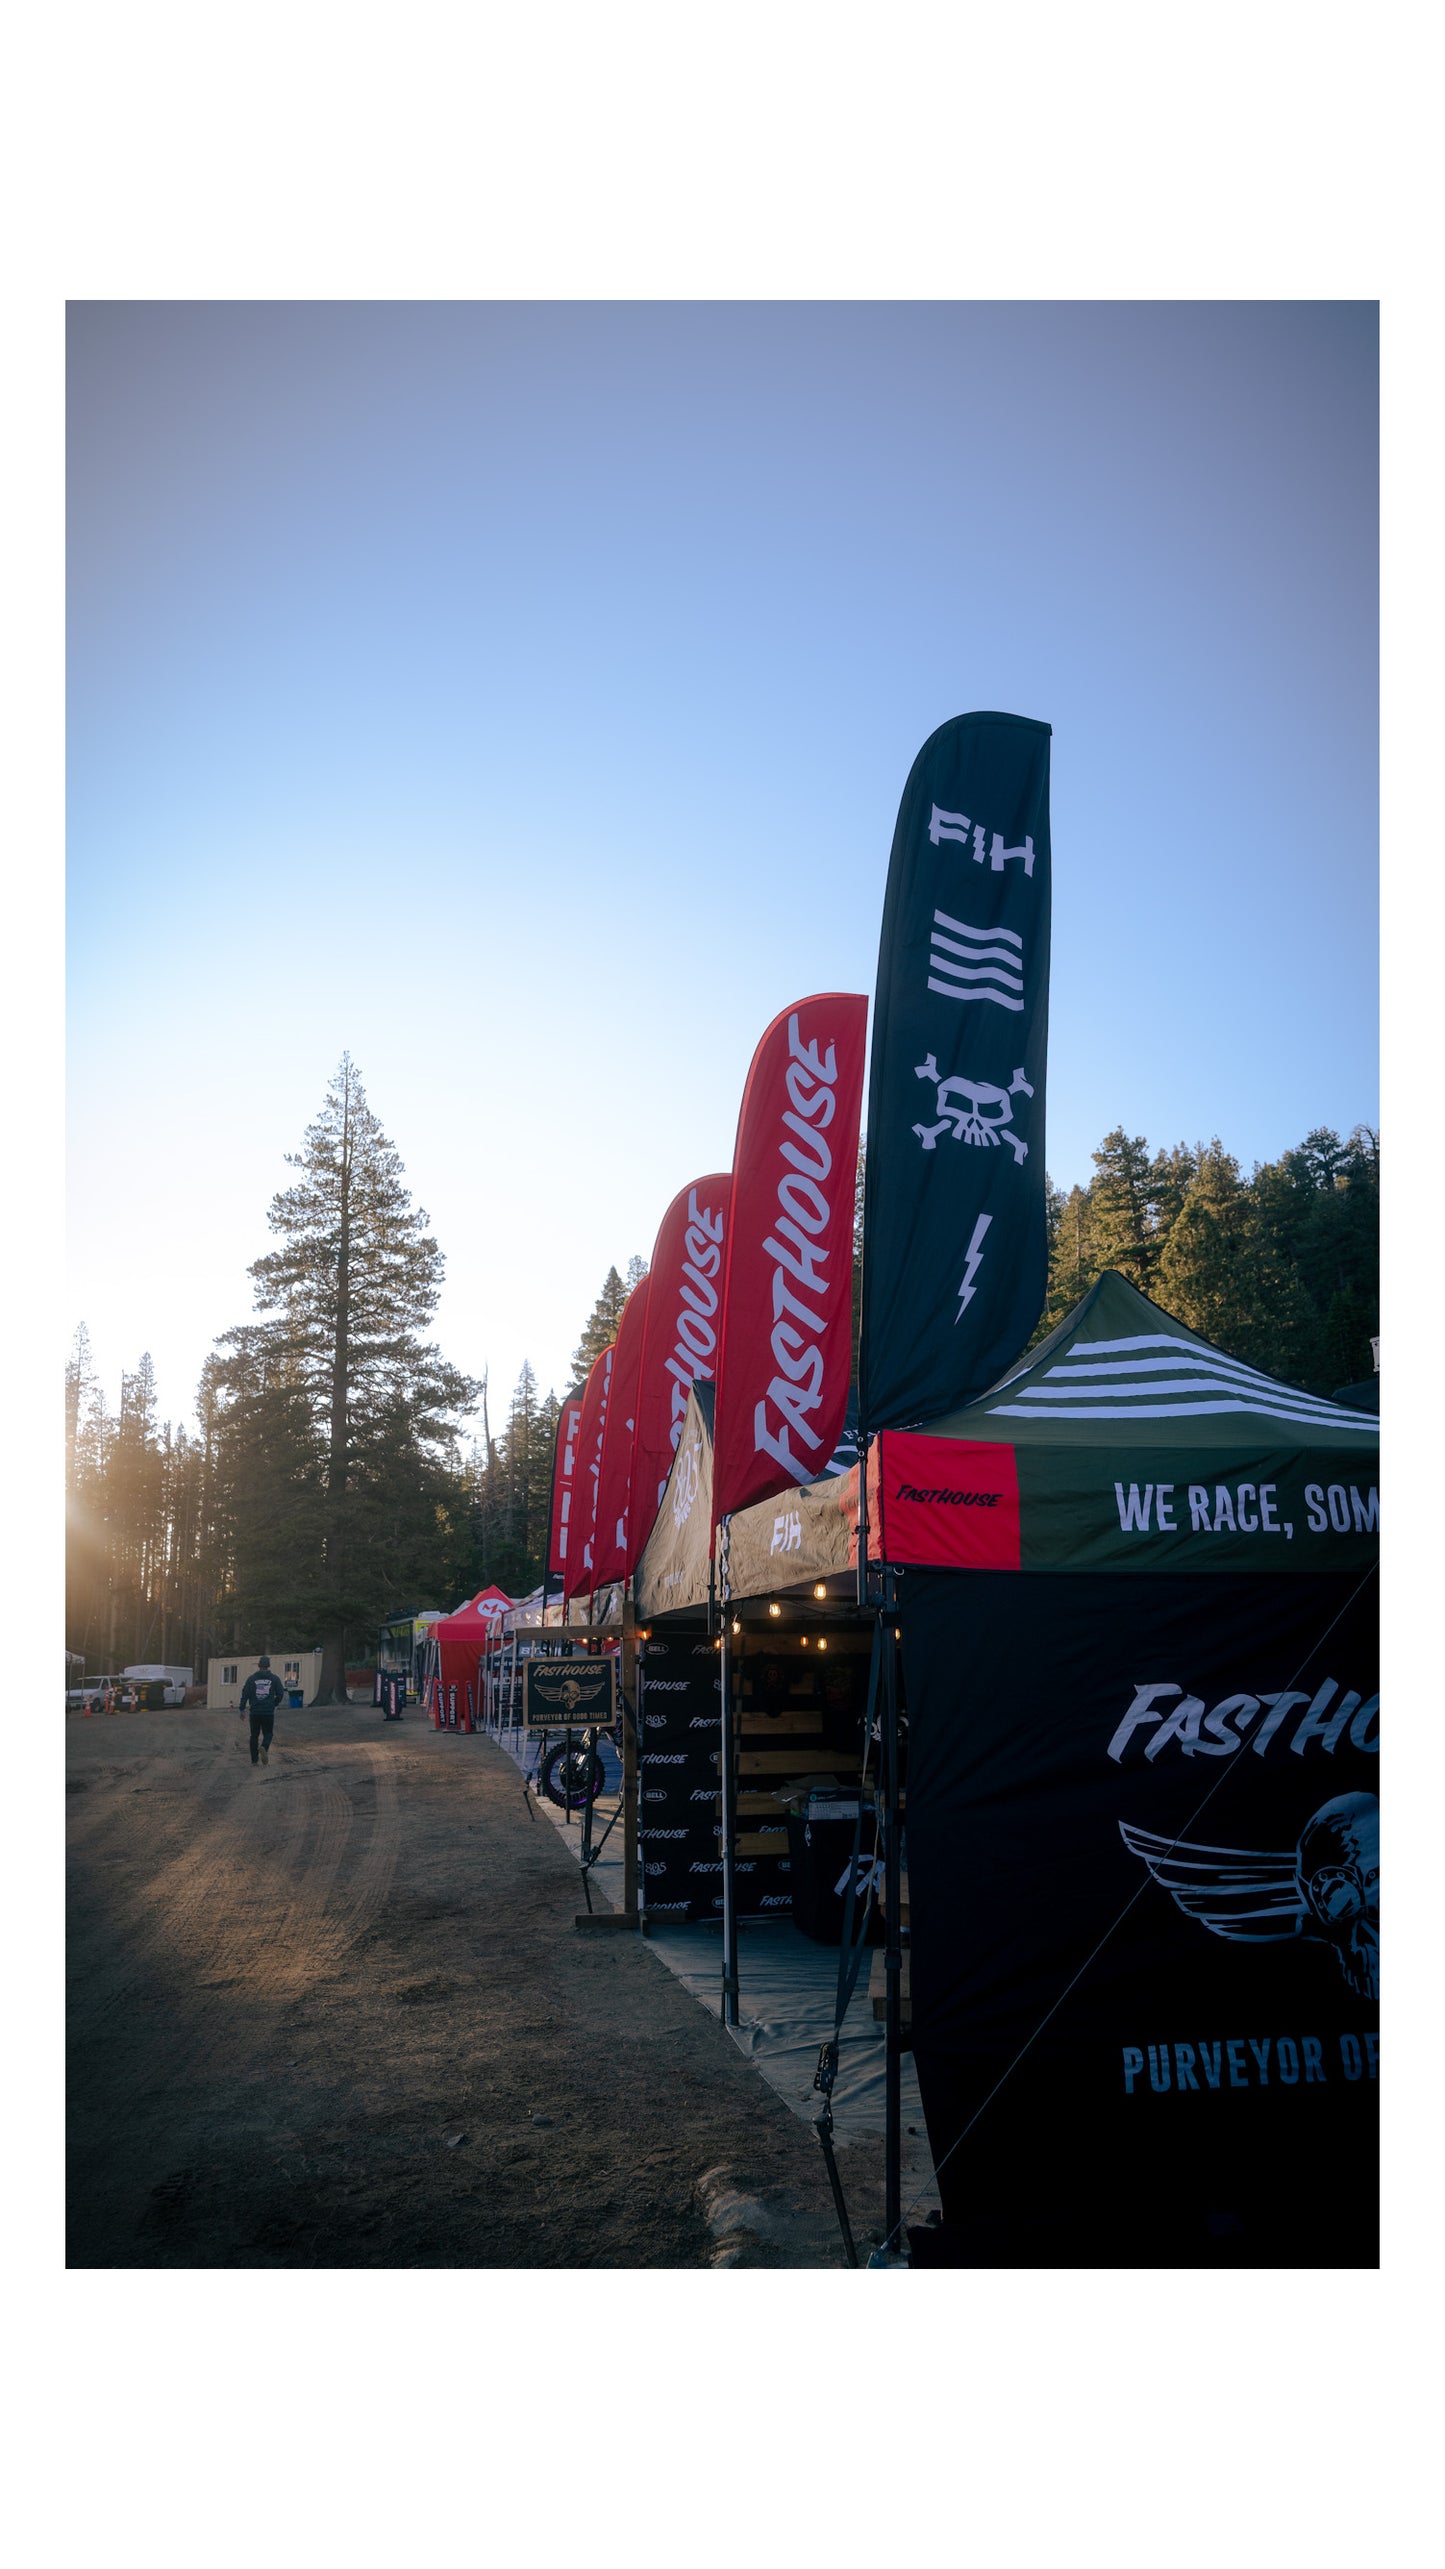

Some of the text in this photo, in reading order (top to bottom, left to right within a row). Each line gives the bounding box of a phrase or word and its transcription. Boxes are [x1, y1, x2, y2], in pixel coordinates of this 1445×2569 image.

[754, 1012, 839, 1486] FASTHOUSE
[895, 1484, 1004, 1507] FASTHOUSE
[1114, 1482, 1379, 1539] WE RACE, SOM
[533, 1664, 606, 1677] FASTHOUSE
[532, 1713, 562, 1721] PURVEYOR
[589, 1711, 608, 1720] TIMES
[645, 1715, 667, 1727] 805
[1122, 2032, 1379, 2094] PURVEYOR OF
